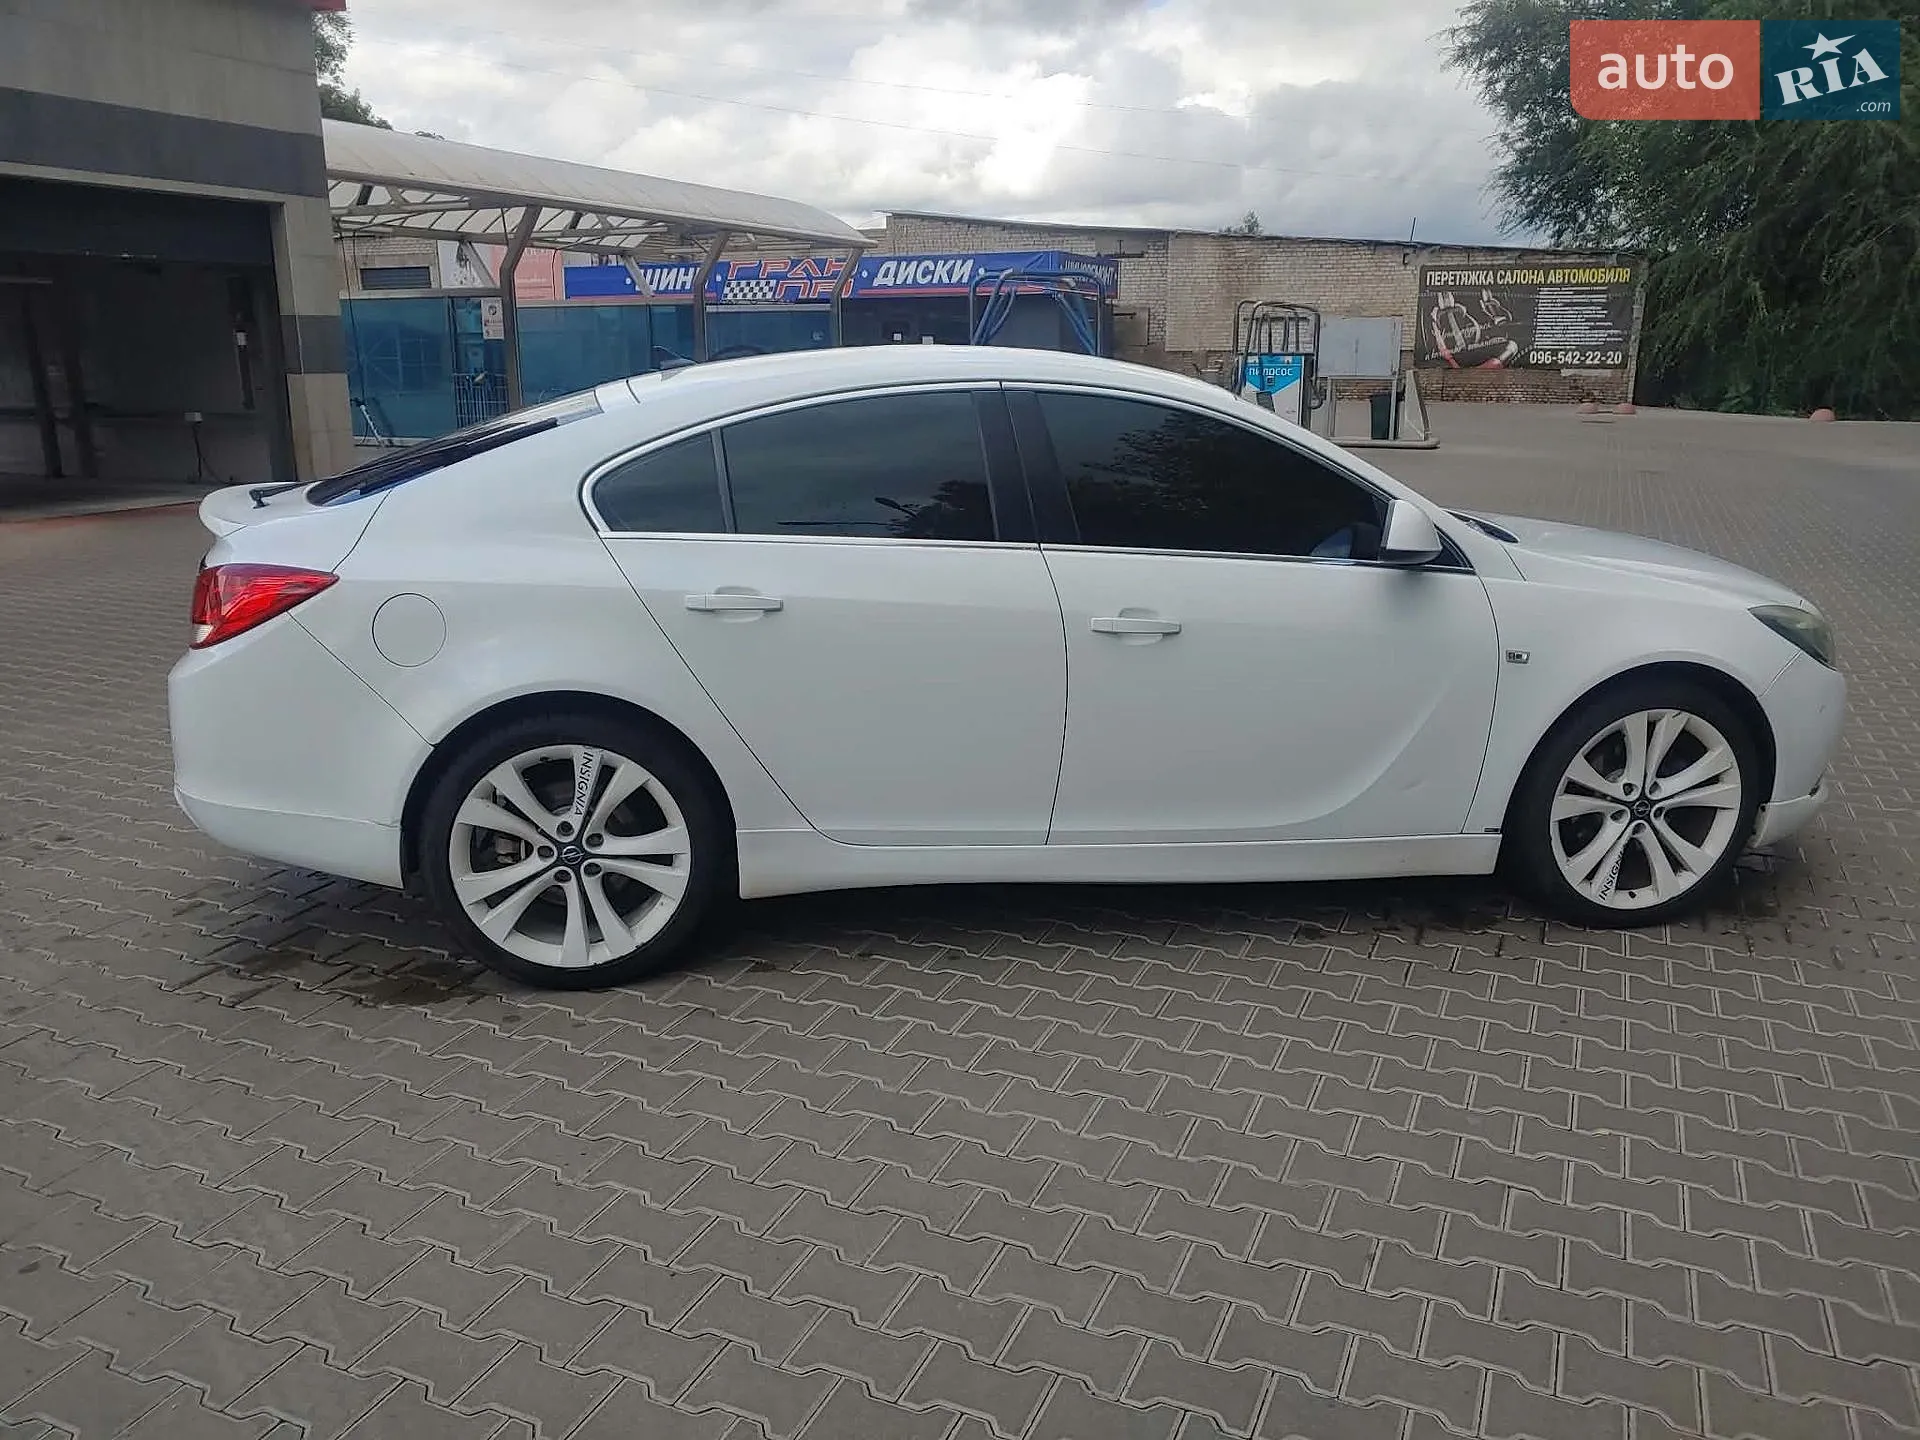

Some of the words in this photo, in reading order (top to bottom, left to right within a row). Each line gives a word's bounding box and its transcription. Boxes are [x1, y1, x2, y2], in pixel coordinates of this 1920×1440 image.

[873, 258, 975, 287] ДИСКИ
[1426, 269, 1494, 286] ПЕРЕТЯЖКА
[1496, 269, 1545, 285] САЛОНА
[1547, 267, 1631, 285] АВТОМОБИЛЯ
[1529, 350, 1622, 365] 096-542-22-20
[575, 752, 594, 816] INSIGNIA
